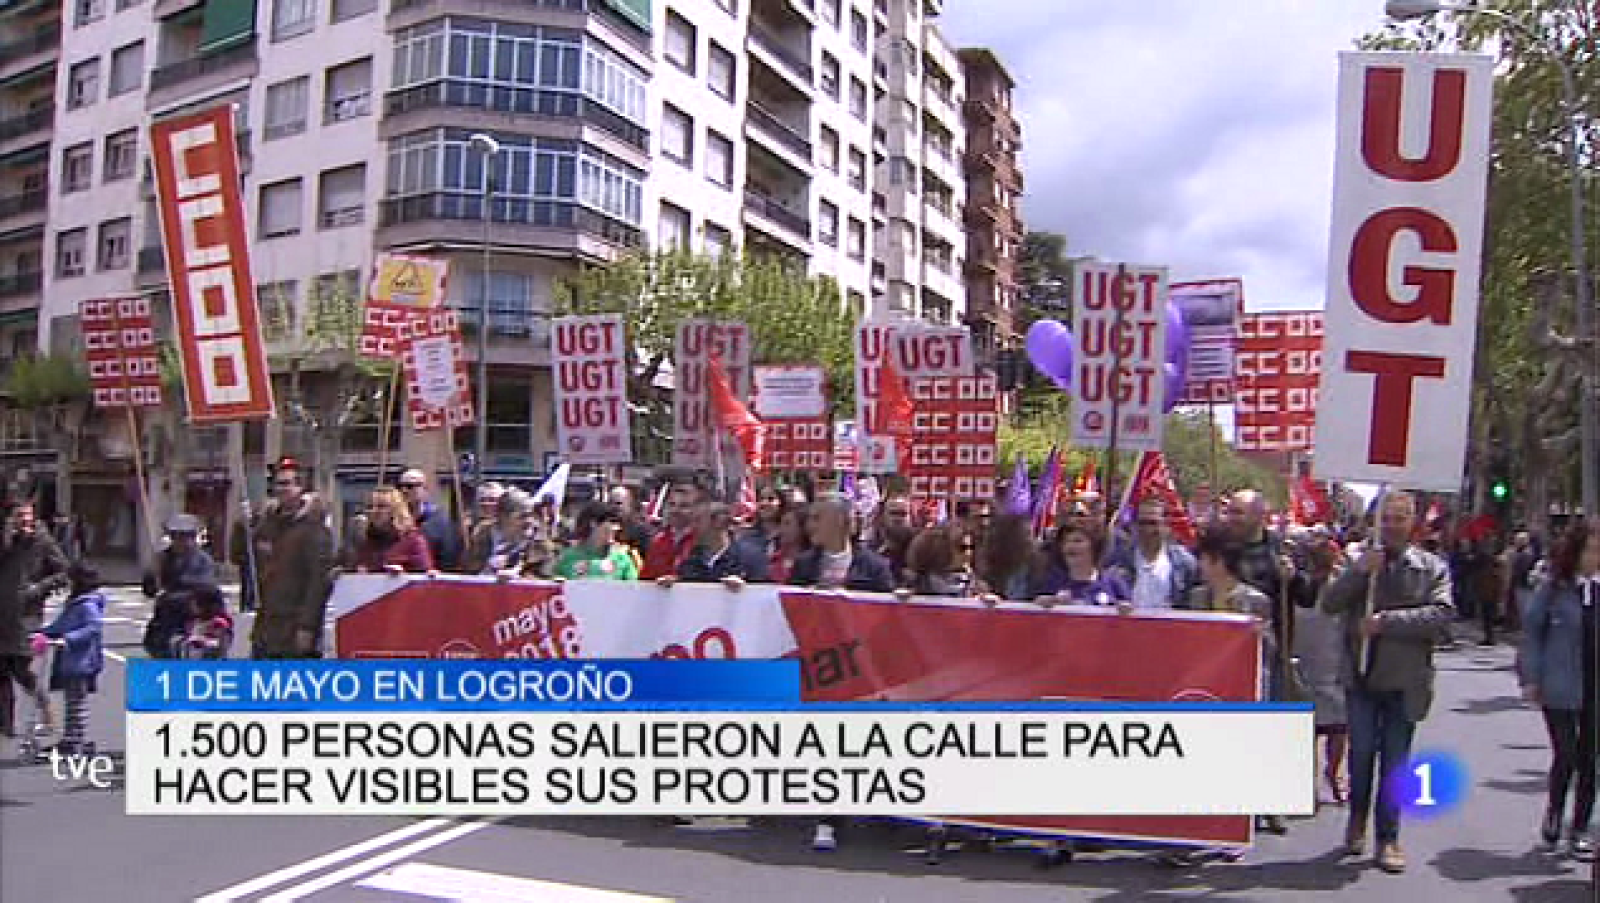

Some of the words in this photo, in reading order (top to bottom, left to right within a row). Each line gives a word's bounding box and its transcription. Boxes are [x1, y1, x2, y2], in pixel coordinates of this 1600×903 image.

[1344, 66, 1467, 468] UGT
[1083, 271, 1159, 313] UGT
[557, 322, 616, 356] UGT
[898, 334, 964, 372] UGT
[1081, 318, 1157, 359] UGT
[560, 358, 619, 392] UGT
[1081, 363, 1155, 405] UGT
[563, 396, 622, 429] UGT
[493, 594, 569, 646] mayo
